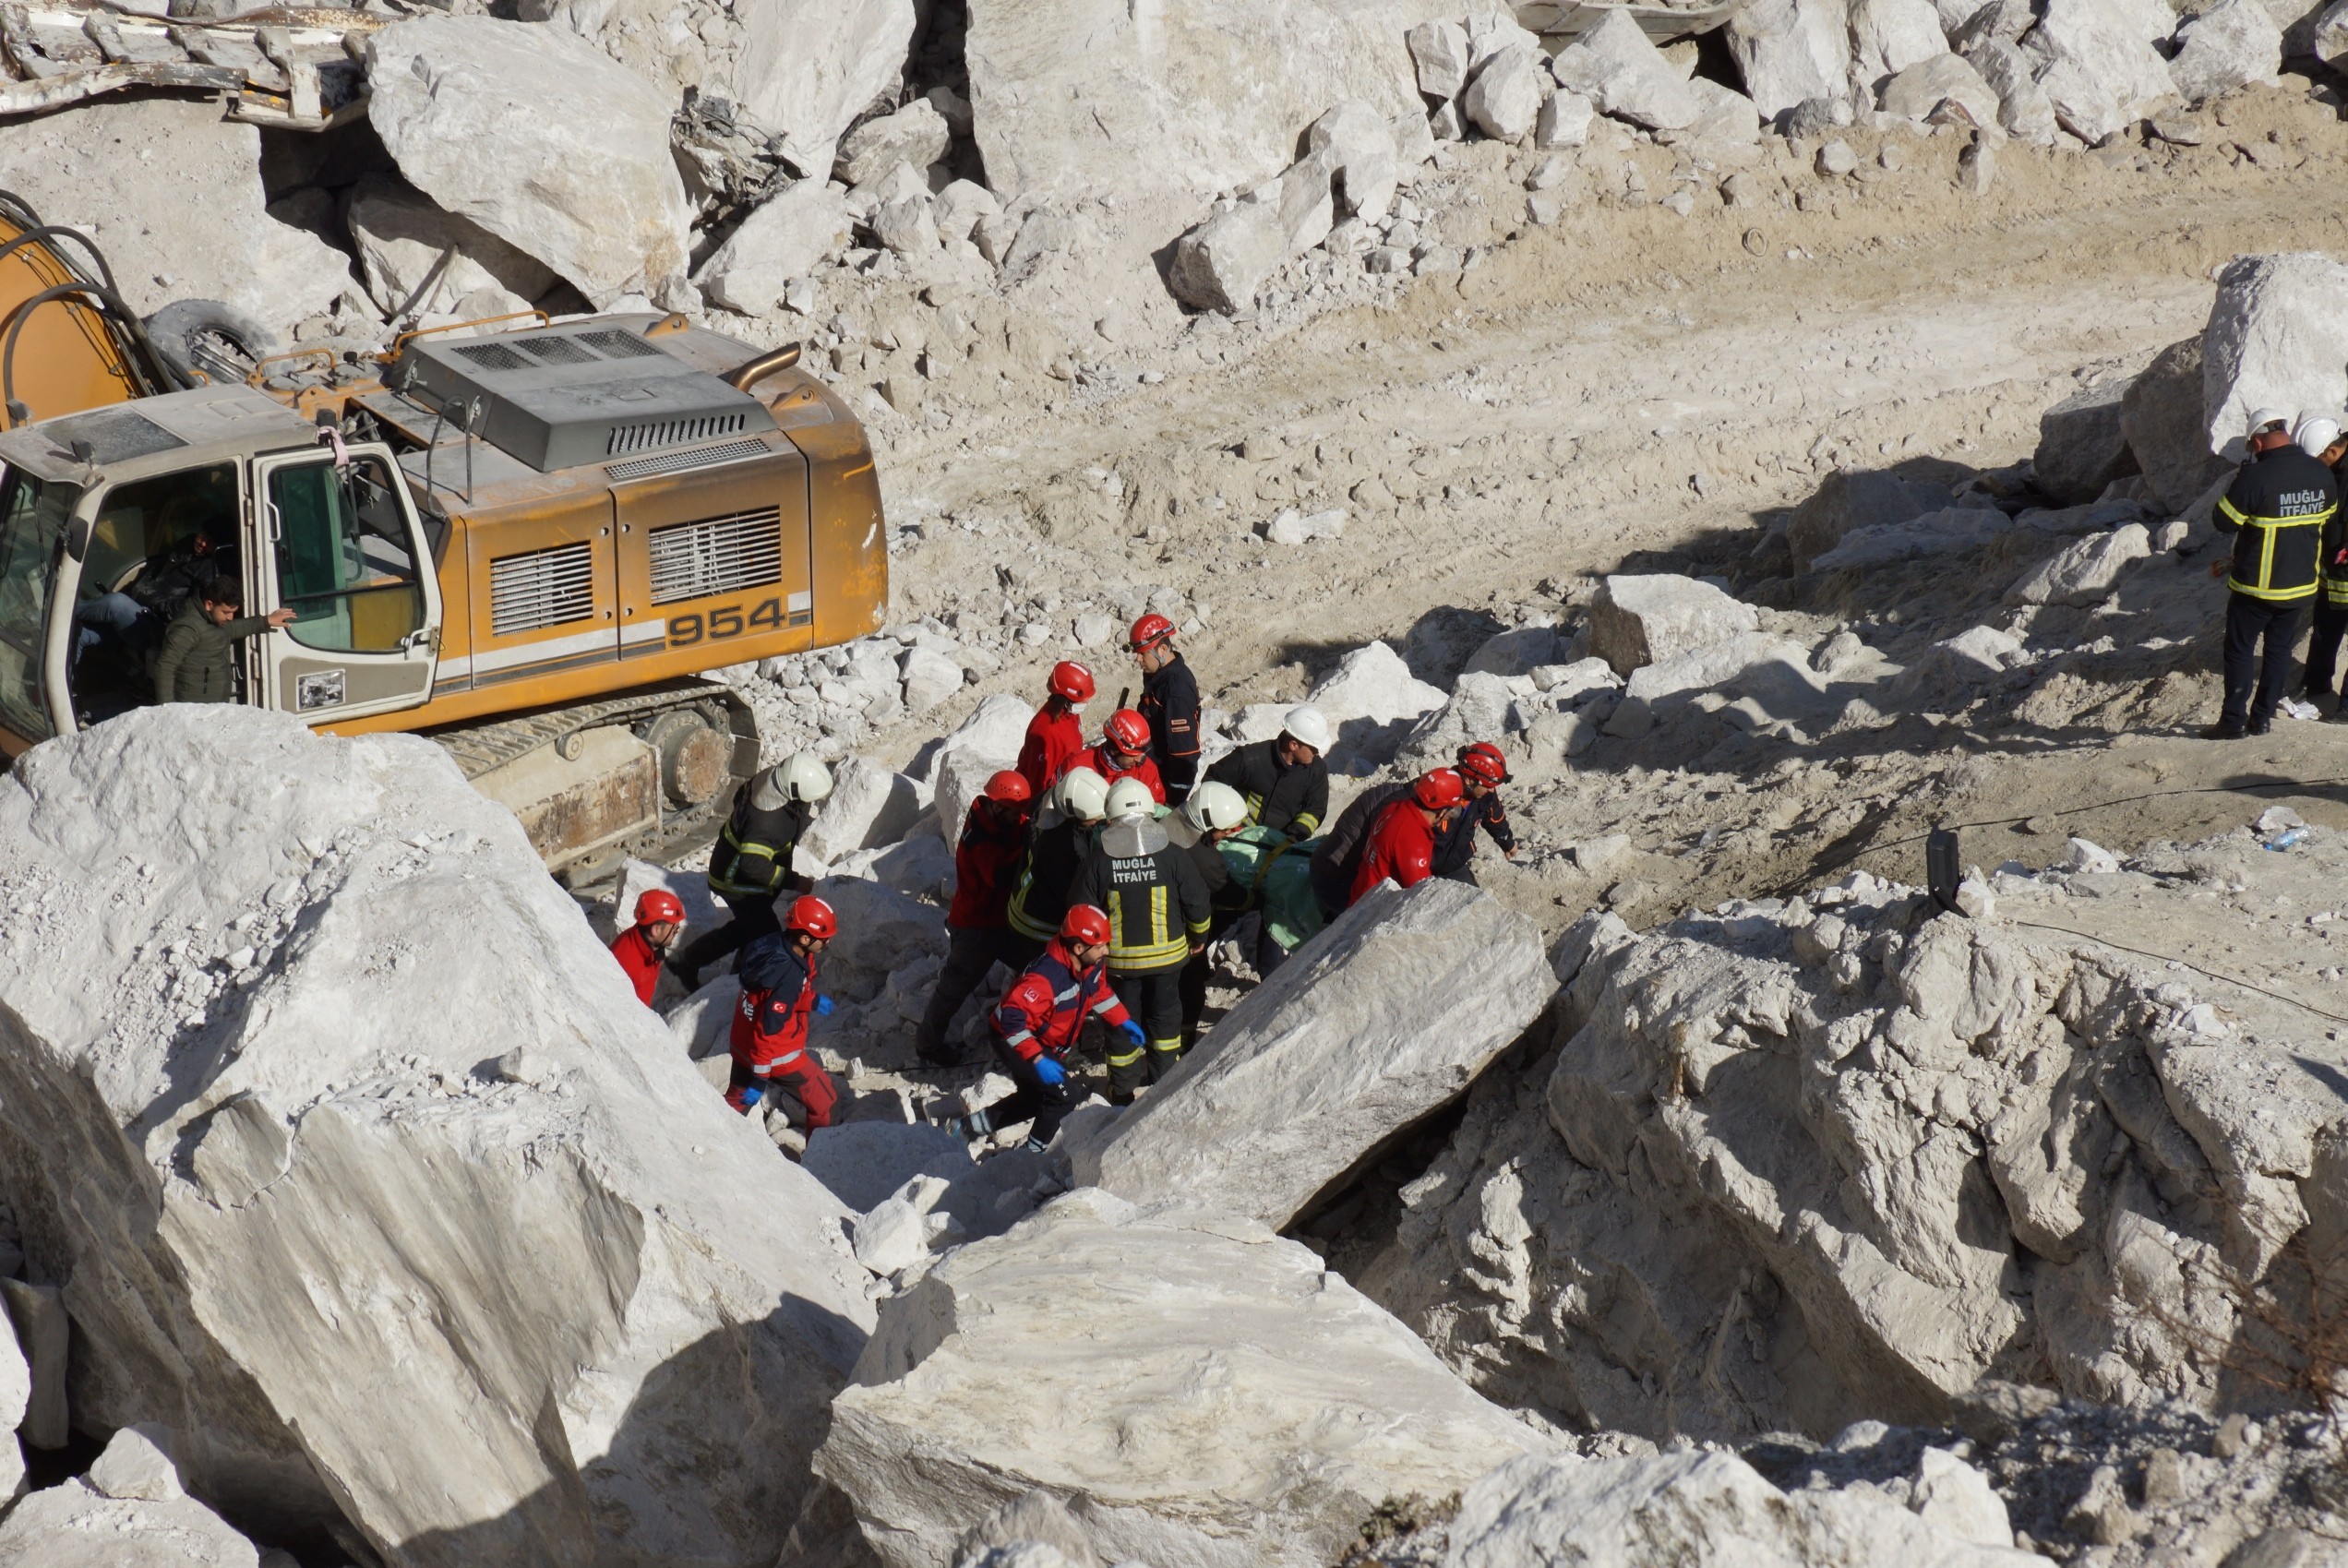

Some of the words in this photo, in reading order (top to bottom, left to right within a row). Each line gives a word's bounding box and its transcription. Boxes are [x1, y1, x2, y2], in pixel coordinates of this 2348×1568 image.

[2280, 489, 2326, 505] MUĞLA
[668, 597, 786, 647] 954
[1113, 869, 1156, 883] İTFAİYE
